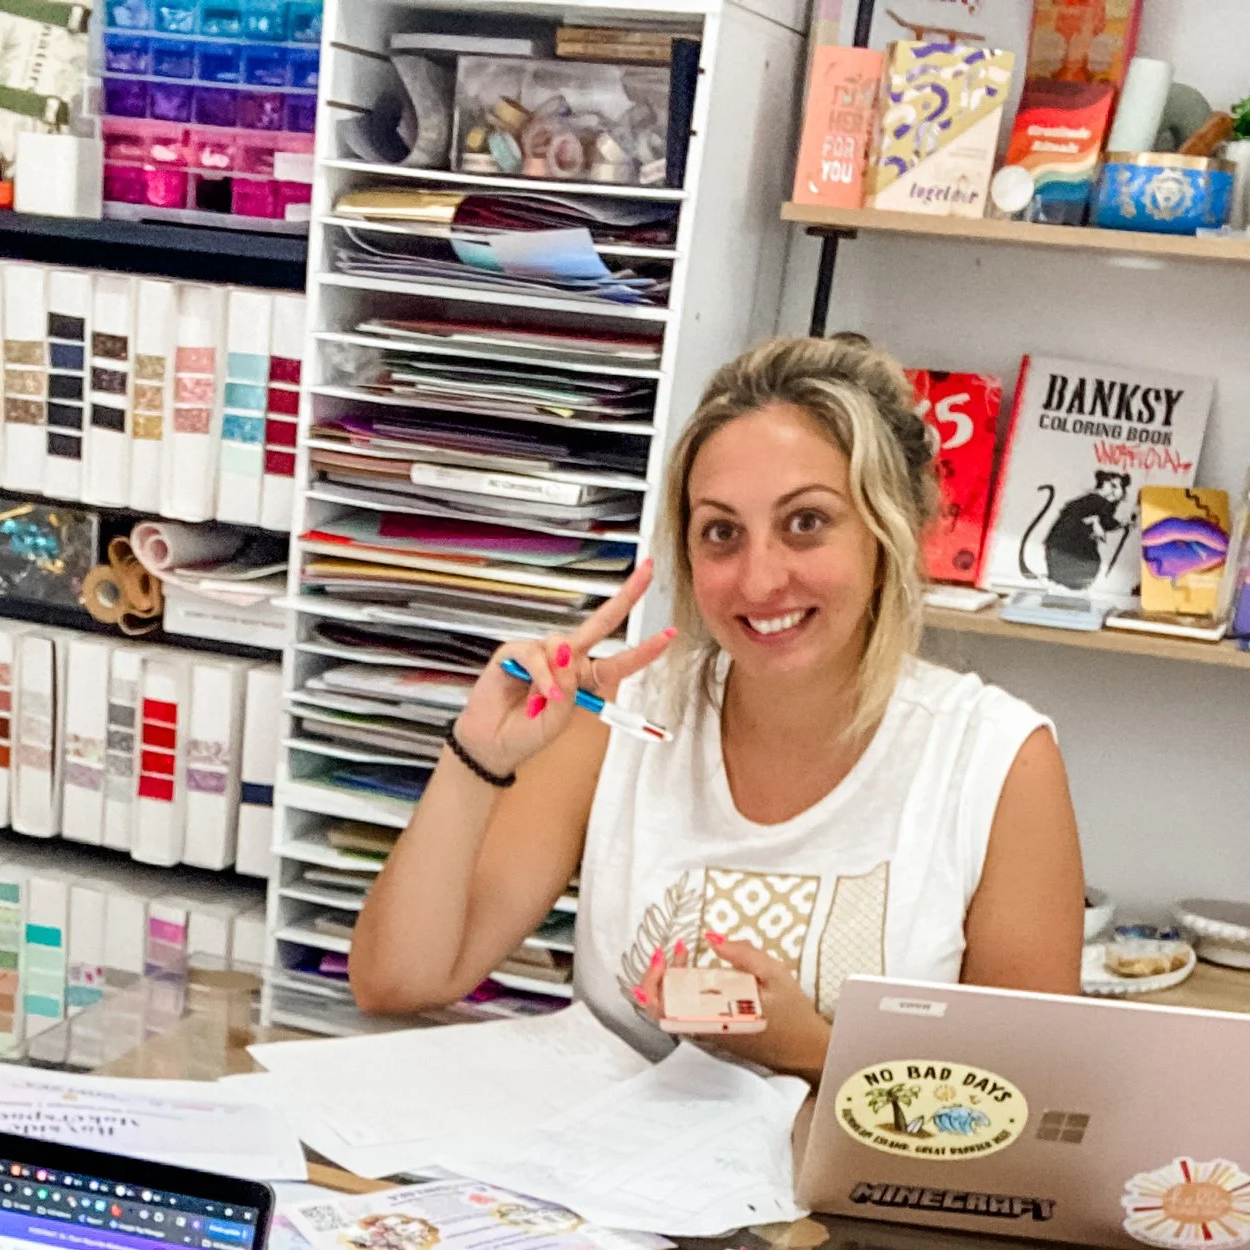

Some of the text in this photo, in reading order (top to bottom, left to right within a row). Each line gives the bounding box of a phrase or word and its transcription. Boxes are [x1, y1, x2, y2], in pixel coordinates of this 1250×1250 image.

[822, 134, 856, 159] FOR
[820, 159, 854, 184] YOU
[1042, 372, 1185, 428] BANKSY
[1038, 413, 1173, 447] COLORING BOOK
[863, 1065, 1013, 1104] NO BAD DAYS
[849, 1180, 1059, 1222] MINECRAFT
